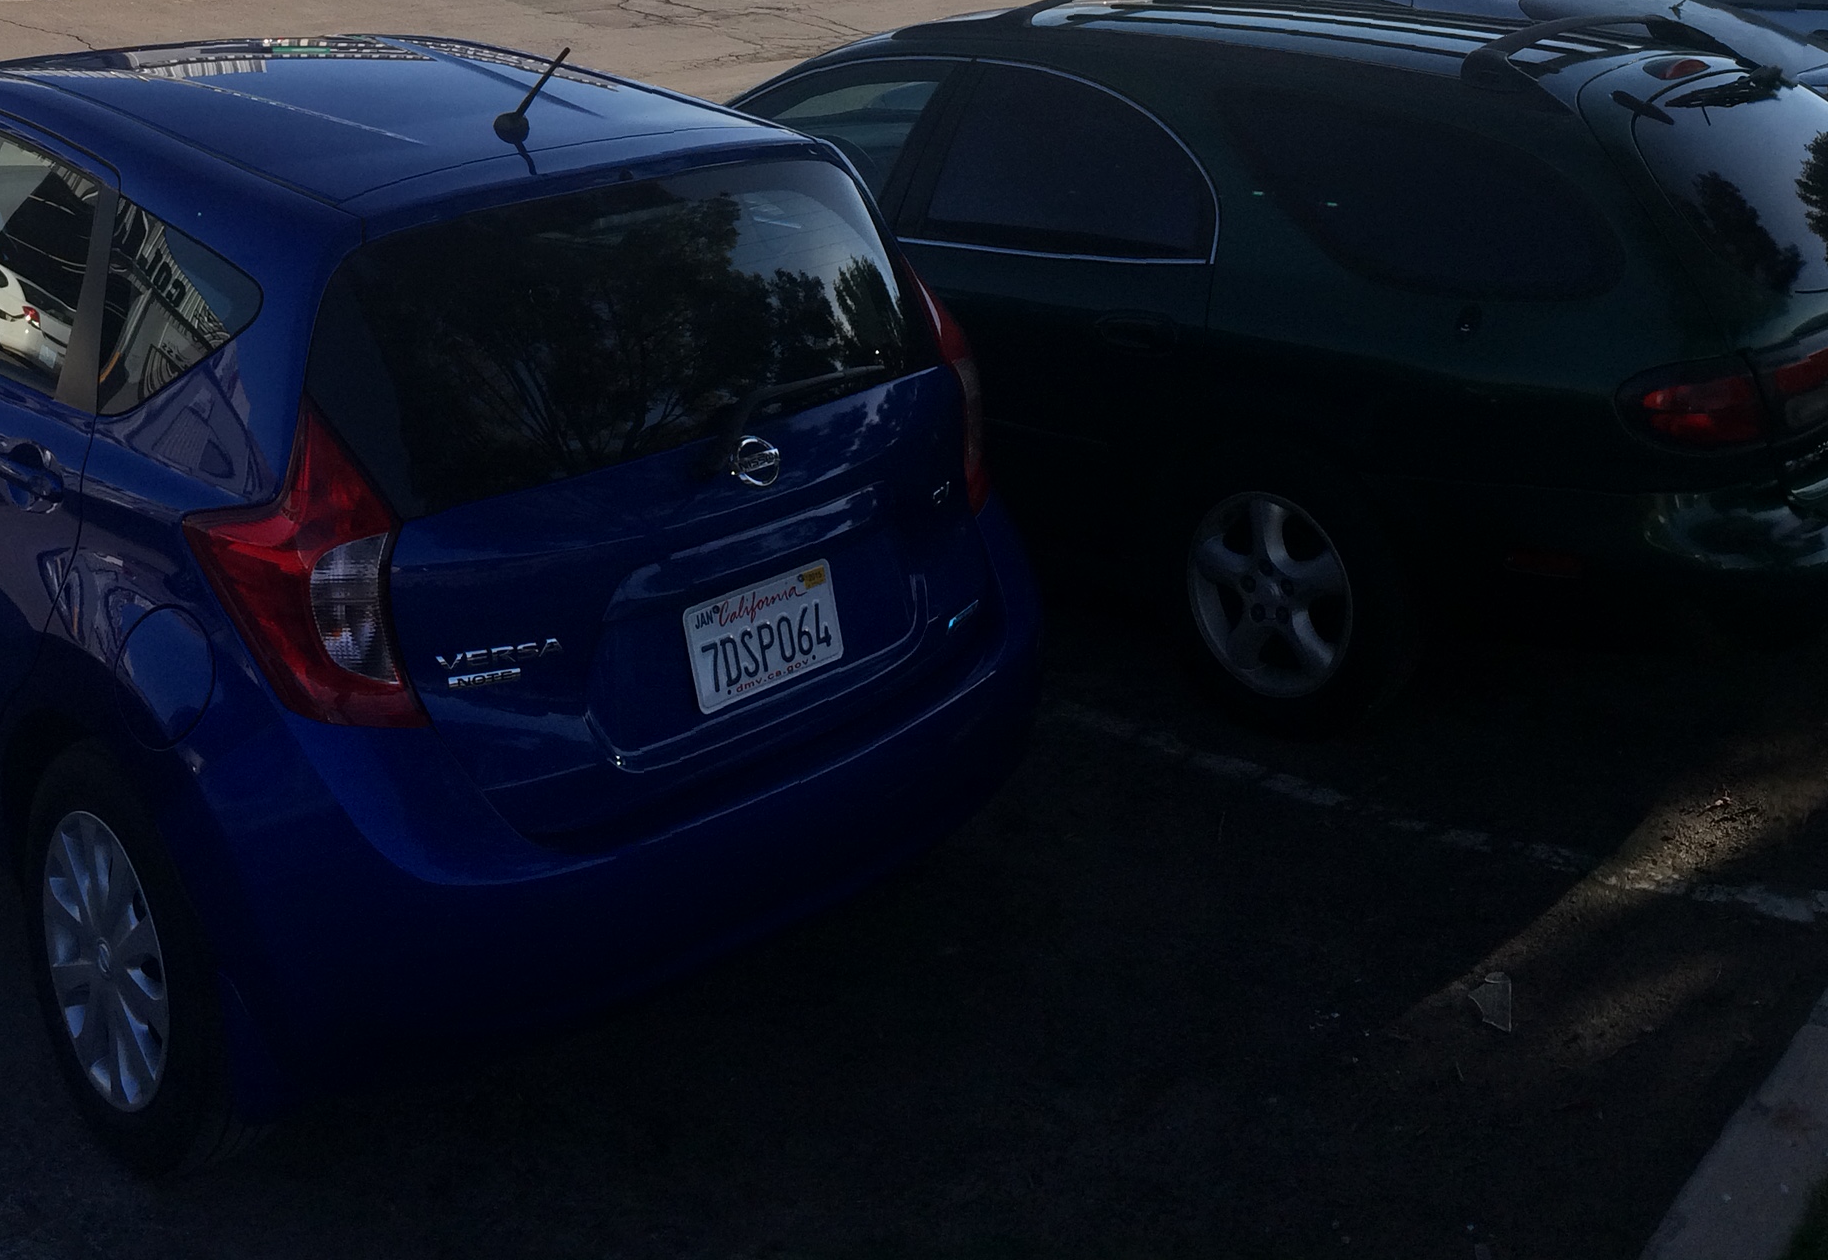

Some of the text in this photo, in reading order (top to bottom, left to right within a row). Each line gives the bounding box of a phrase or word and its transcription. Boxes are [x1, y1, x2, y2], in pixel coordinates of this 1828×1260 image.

[695, 610, 714, 630] JAN
[718, 585, 807, 627] California
[436, 637, 563, 670] VERSA
[700, 603, 832, 693] 7DSP064
[456, 669, 514, 688] NOTE
[735, 658, 809, 693] dmv.ca.gov
